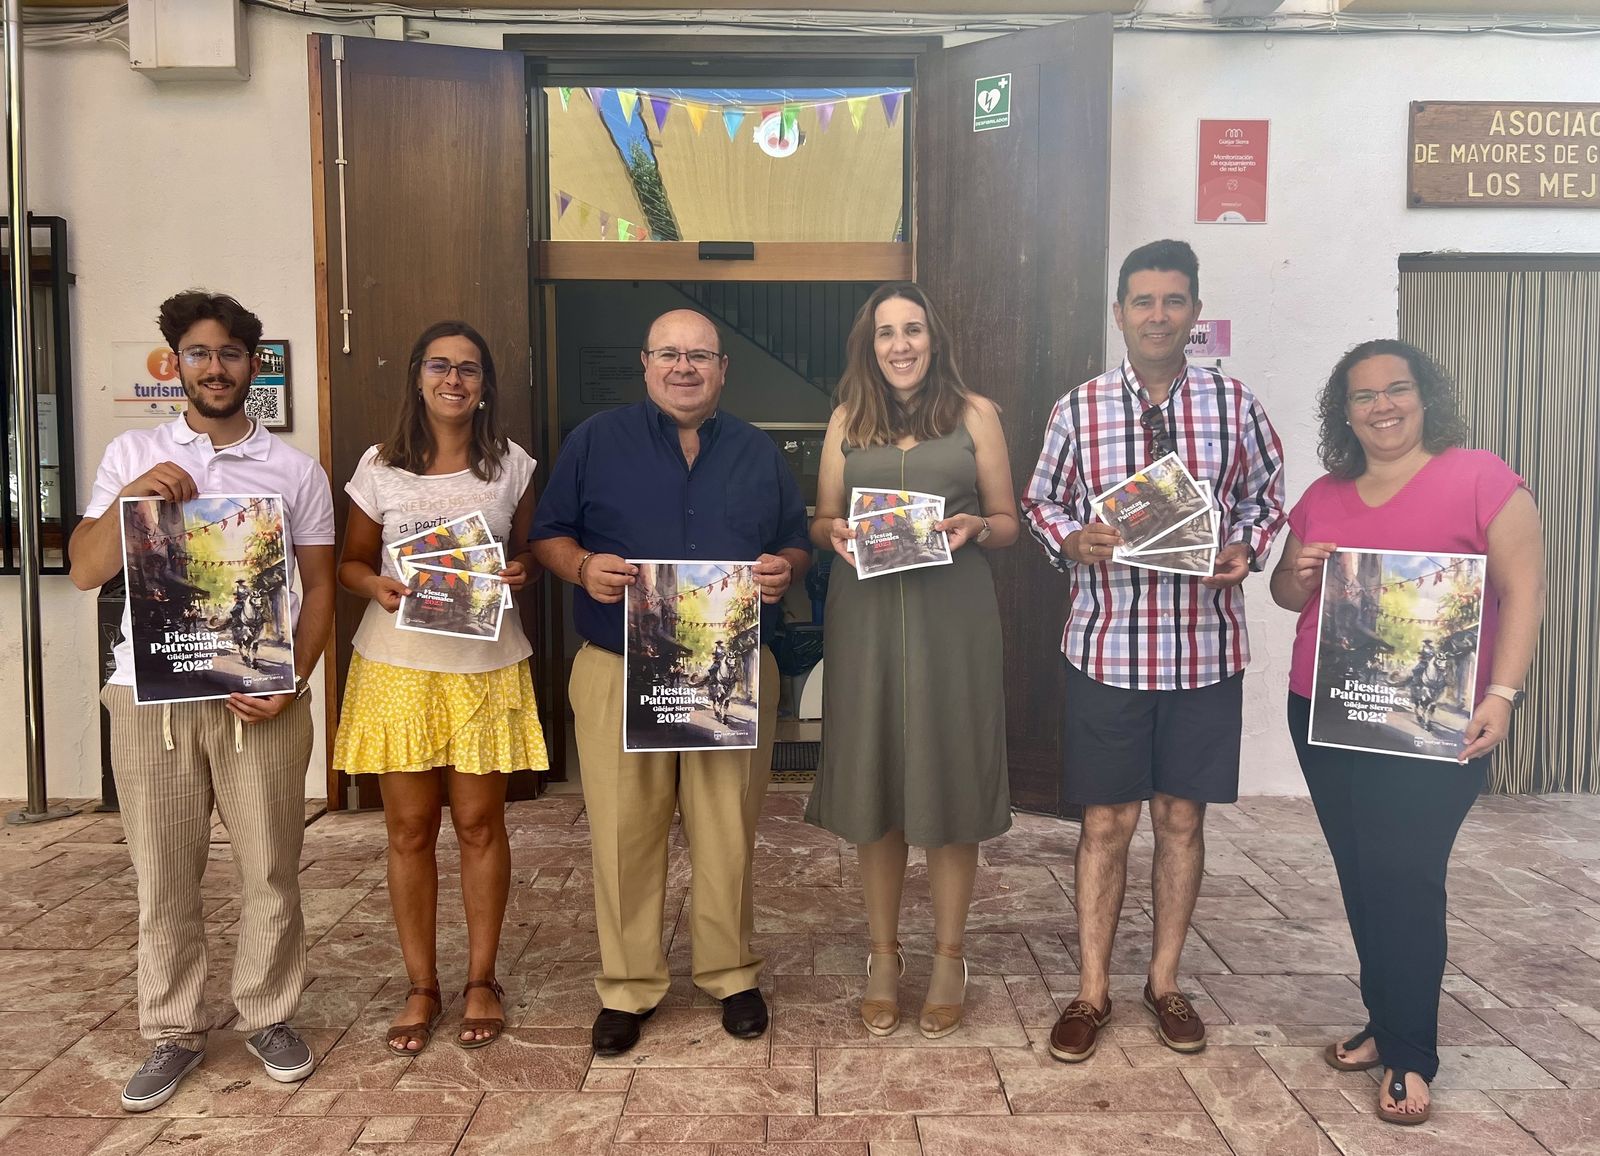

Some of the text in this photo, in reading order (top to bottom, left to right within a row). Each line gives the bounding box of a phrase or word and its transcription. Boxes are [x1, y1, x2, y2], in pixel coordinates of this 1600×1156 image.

[1489, 110, 1600, 137] ASOCIAC
[1414, 143, 1440, 164] DE
[1450, 143, 1546, 164] MAYORES
[1554, 144, 1579, 164] DE
[1468, 172, 1597, 198] LOS MEJ
[134, 383, 185, 398] turism
[164, 631, 219, 643] Fiestas
[150, 640, 233, 654] Patronales
[172, 660, 214, 673] 2023
[652, 685, 697, 696] Fiestas
[1344, 679, 1397, 695] Fiestas
[640, 694, 709, 705] Patronales
[1330, 687, 1410, 706] Patronales
[1369, 704, 1393, 712] Sierra
[656, 712, 691, 724] 2023
[1347, 709, 1387, 724] 2023
